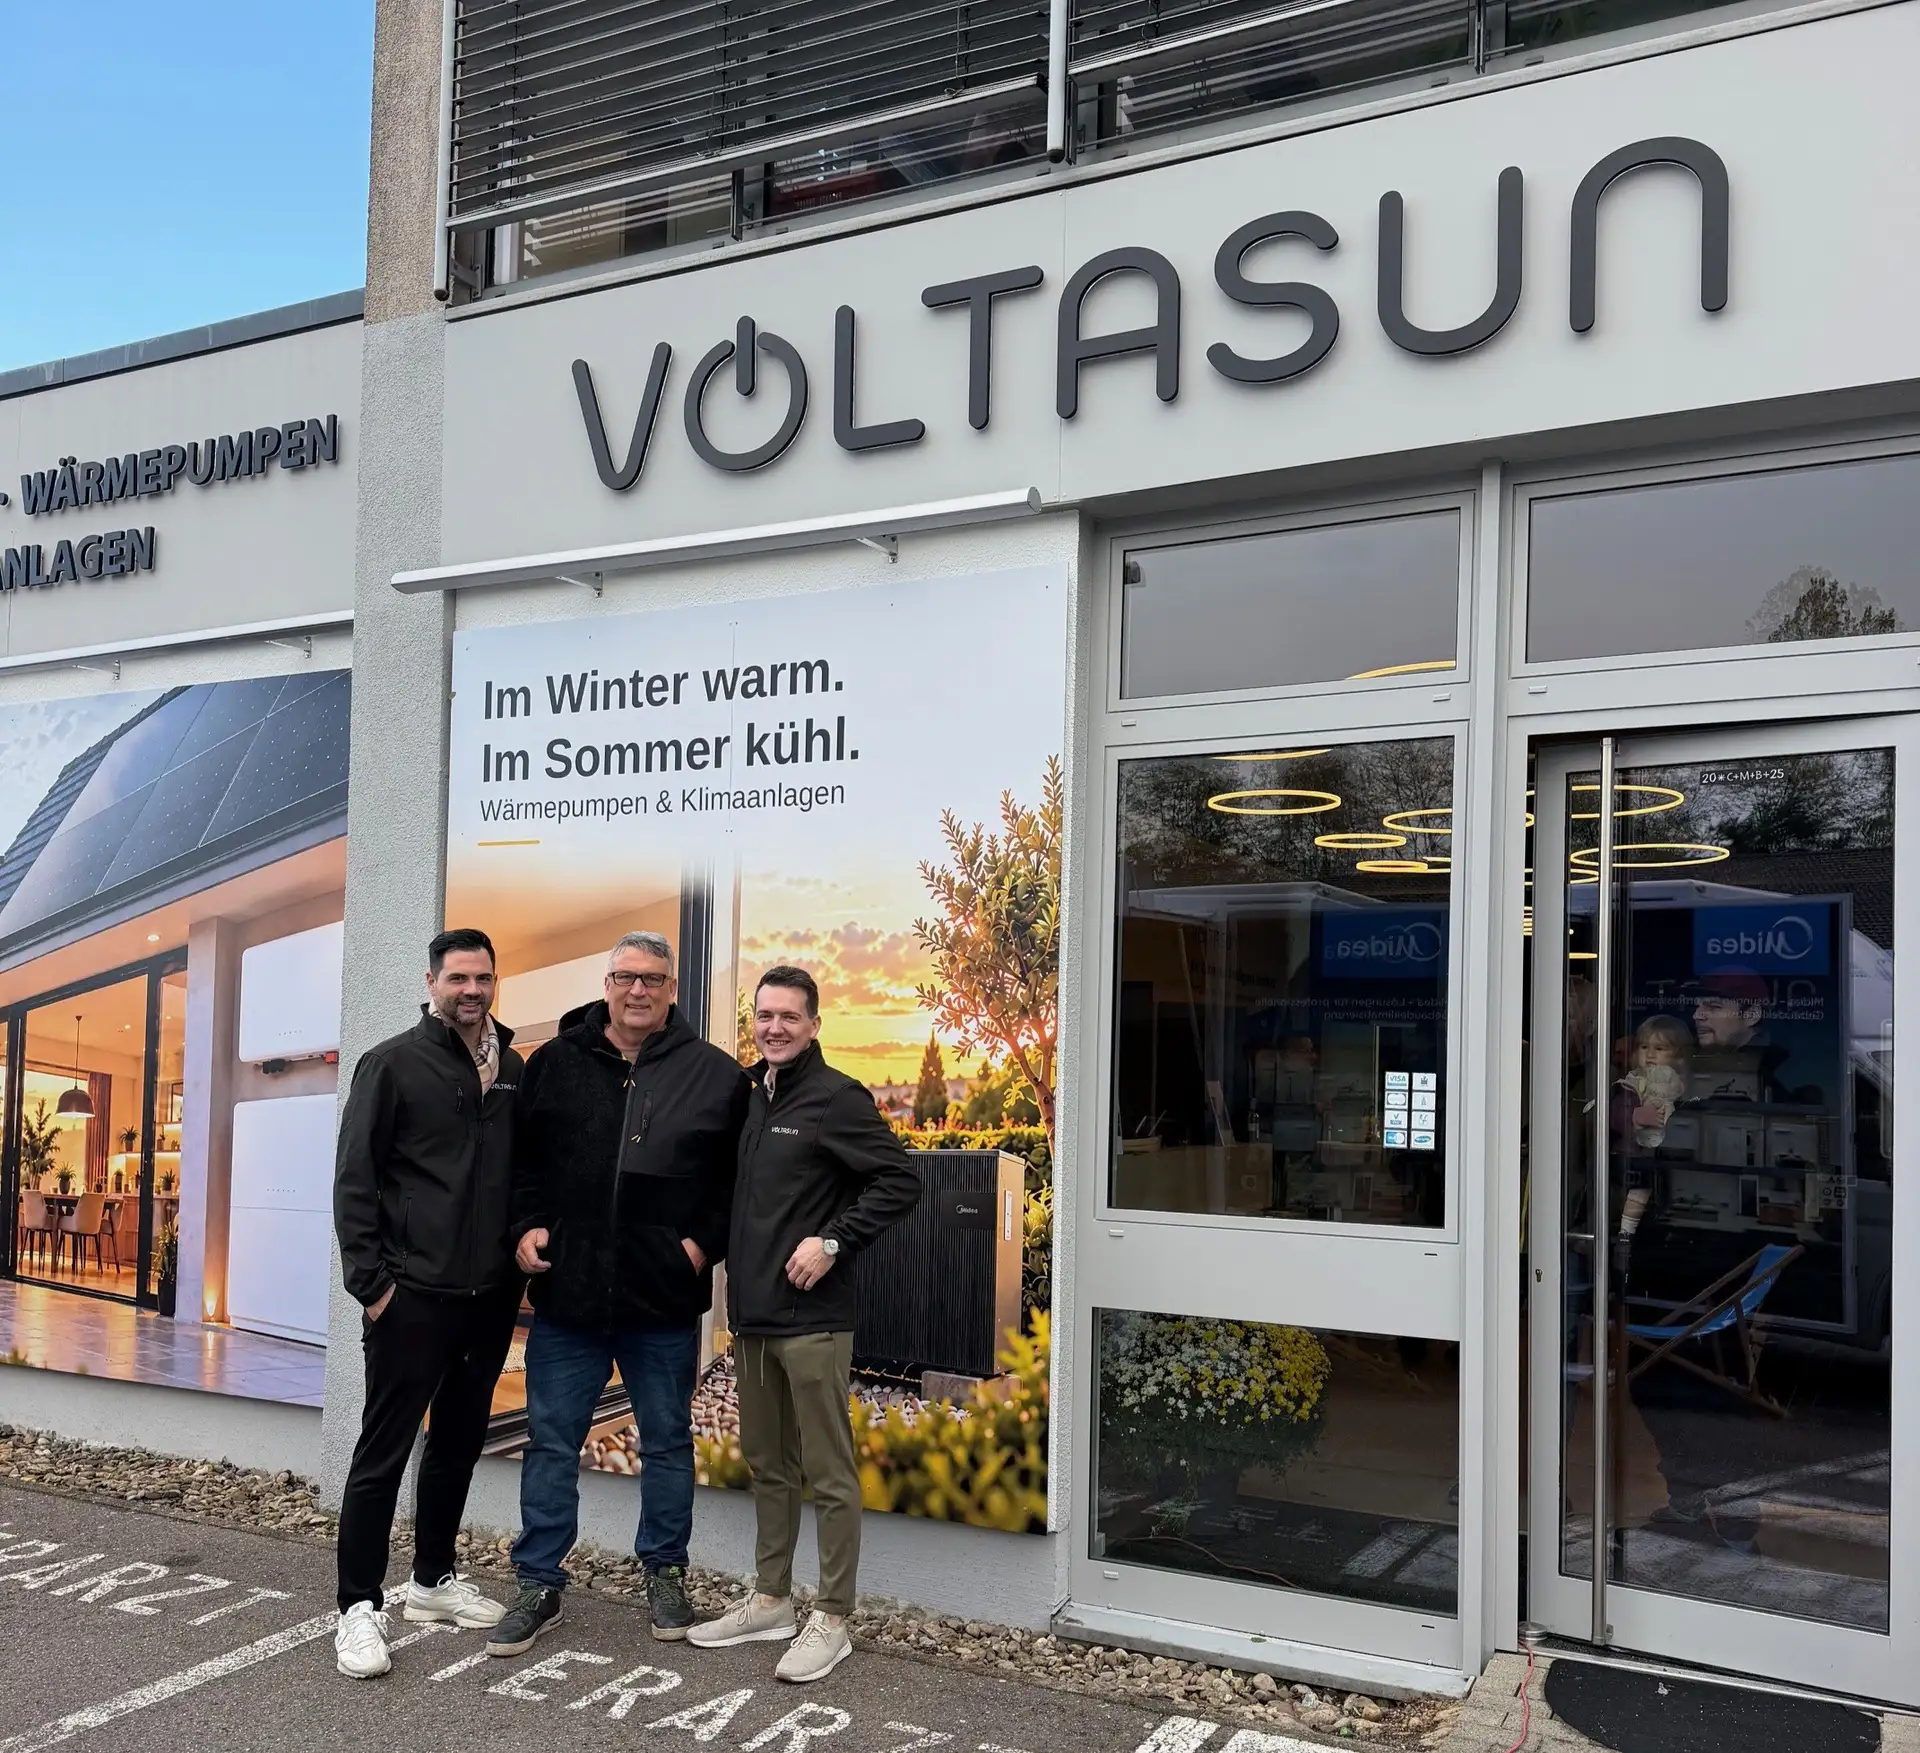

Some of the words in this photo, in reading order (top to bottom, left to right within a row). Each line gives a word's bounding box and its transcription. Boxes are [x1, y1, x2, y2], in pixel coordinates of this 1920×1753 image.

[572, 136, 1730, 492] VOLTASUN
[20, 414, 339, 516] WÄRMEPUMPEN
[0, 526, 156, 591] NLAGEN
[484, 680, 531, 719] Im
[546, 669, 689, 715] Winter
[702, 657, 844, 702] warm.
[482, 744, 530, 783] Im
[544, 734, 731, 779] Sommer
[746, 715, 860, 767] kühl.
[480, 790, 648, 824] Wärmepumpen
[655, 789, 673, 813] &
[680, 782, 845, 818] Klimaanlagen
